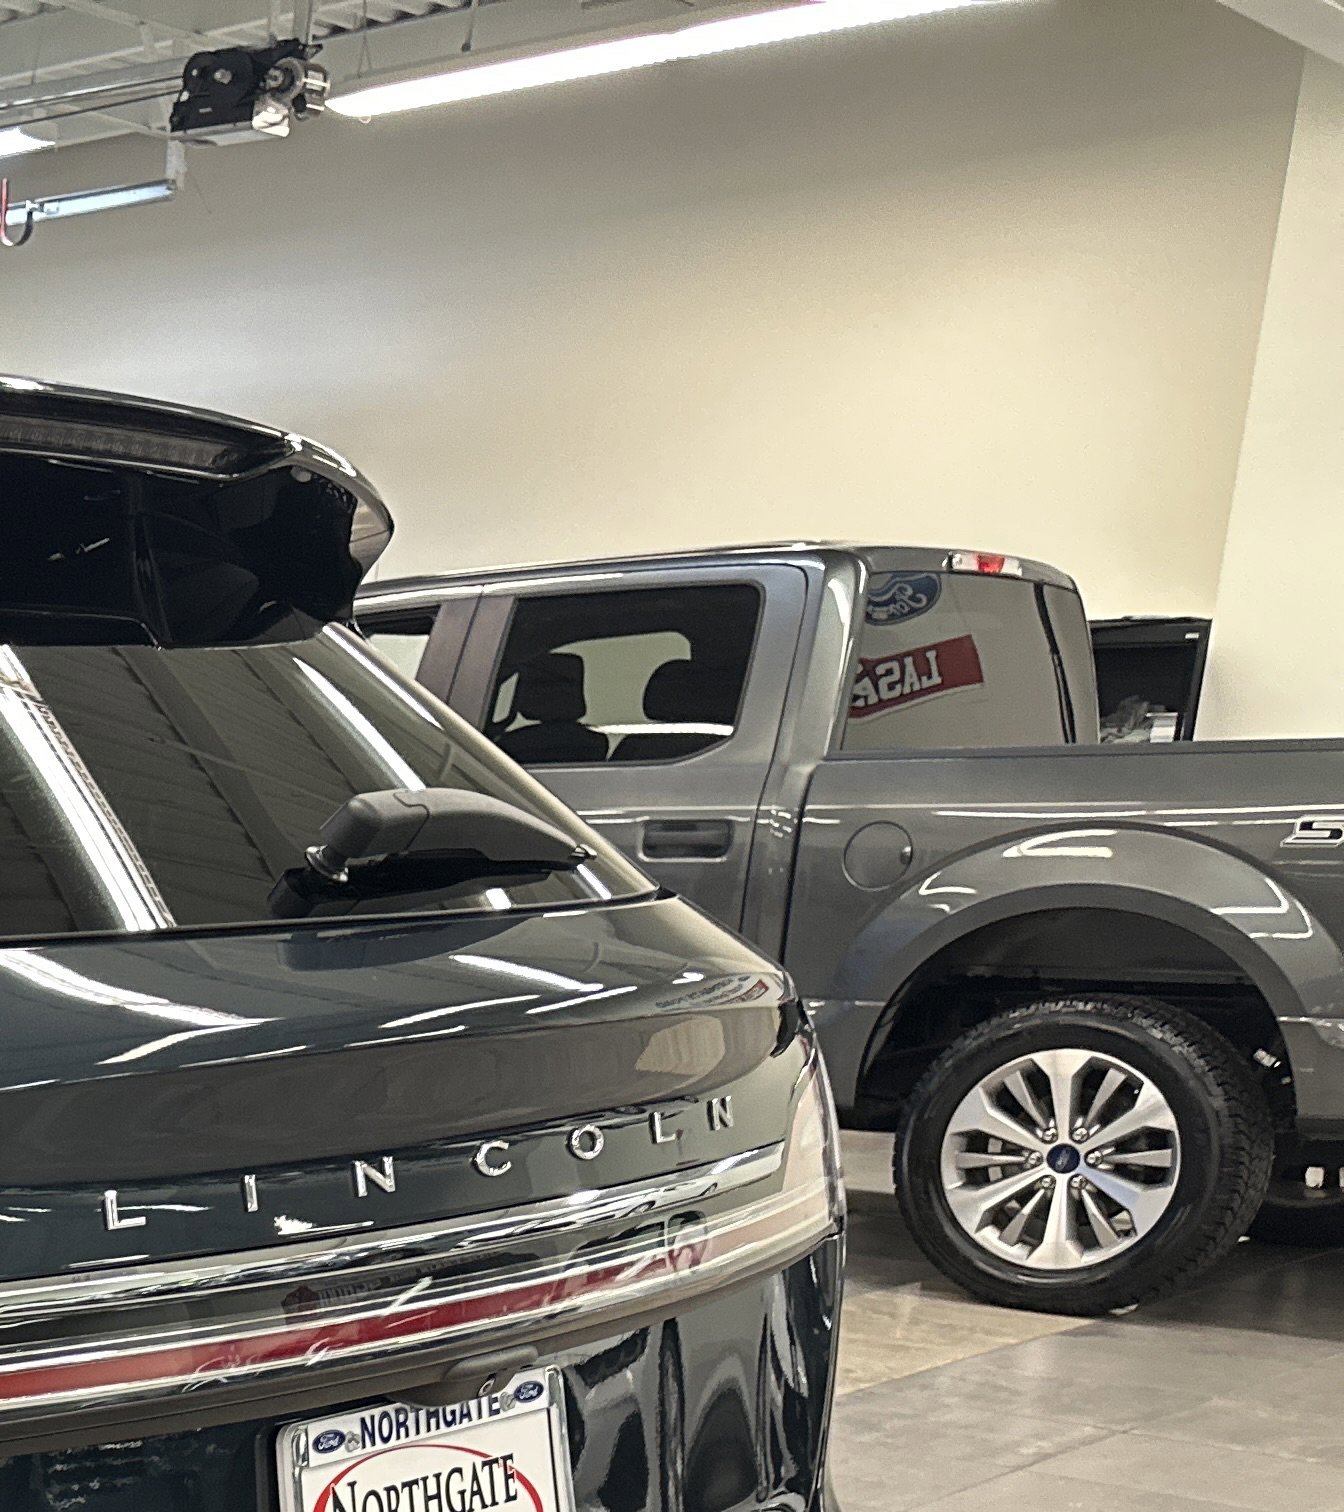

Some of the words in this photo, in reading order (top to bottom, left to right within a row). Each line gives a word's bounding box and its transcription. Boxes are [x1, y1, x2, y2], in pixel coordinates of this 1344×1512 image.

[103, 1097, 734, 1231] LINCOLN
[316, 1432, 345, 1452] Ford
[359, 1393, 501, 1449] NORTHGATE
[517, 1382, 541, 1401] Ford
